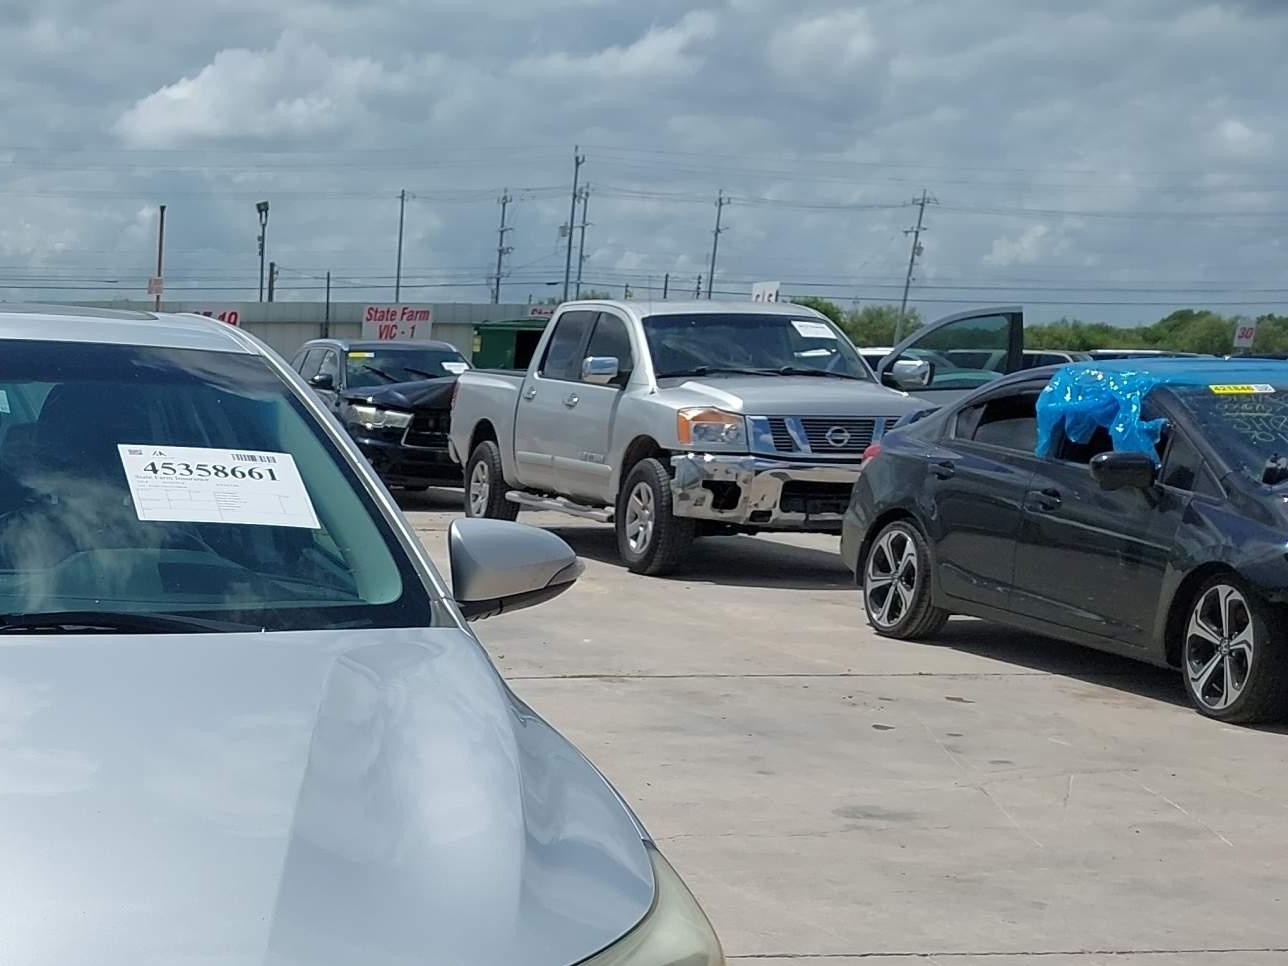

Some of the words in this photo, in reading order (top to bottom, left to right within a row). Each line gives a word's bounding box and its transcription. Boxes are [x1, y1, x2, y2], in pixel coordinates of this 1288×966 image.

[366, 306, 398, 321] State
[400, 306, 430, 321] Farm
[378, 324, 398, 340] VIC
[1237, 326, 1254, 340] 30
[143, 461, 281, 482] 45358661
